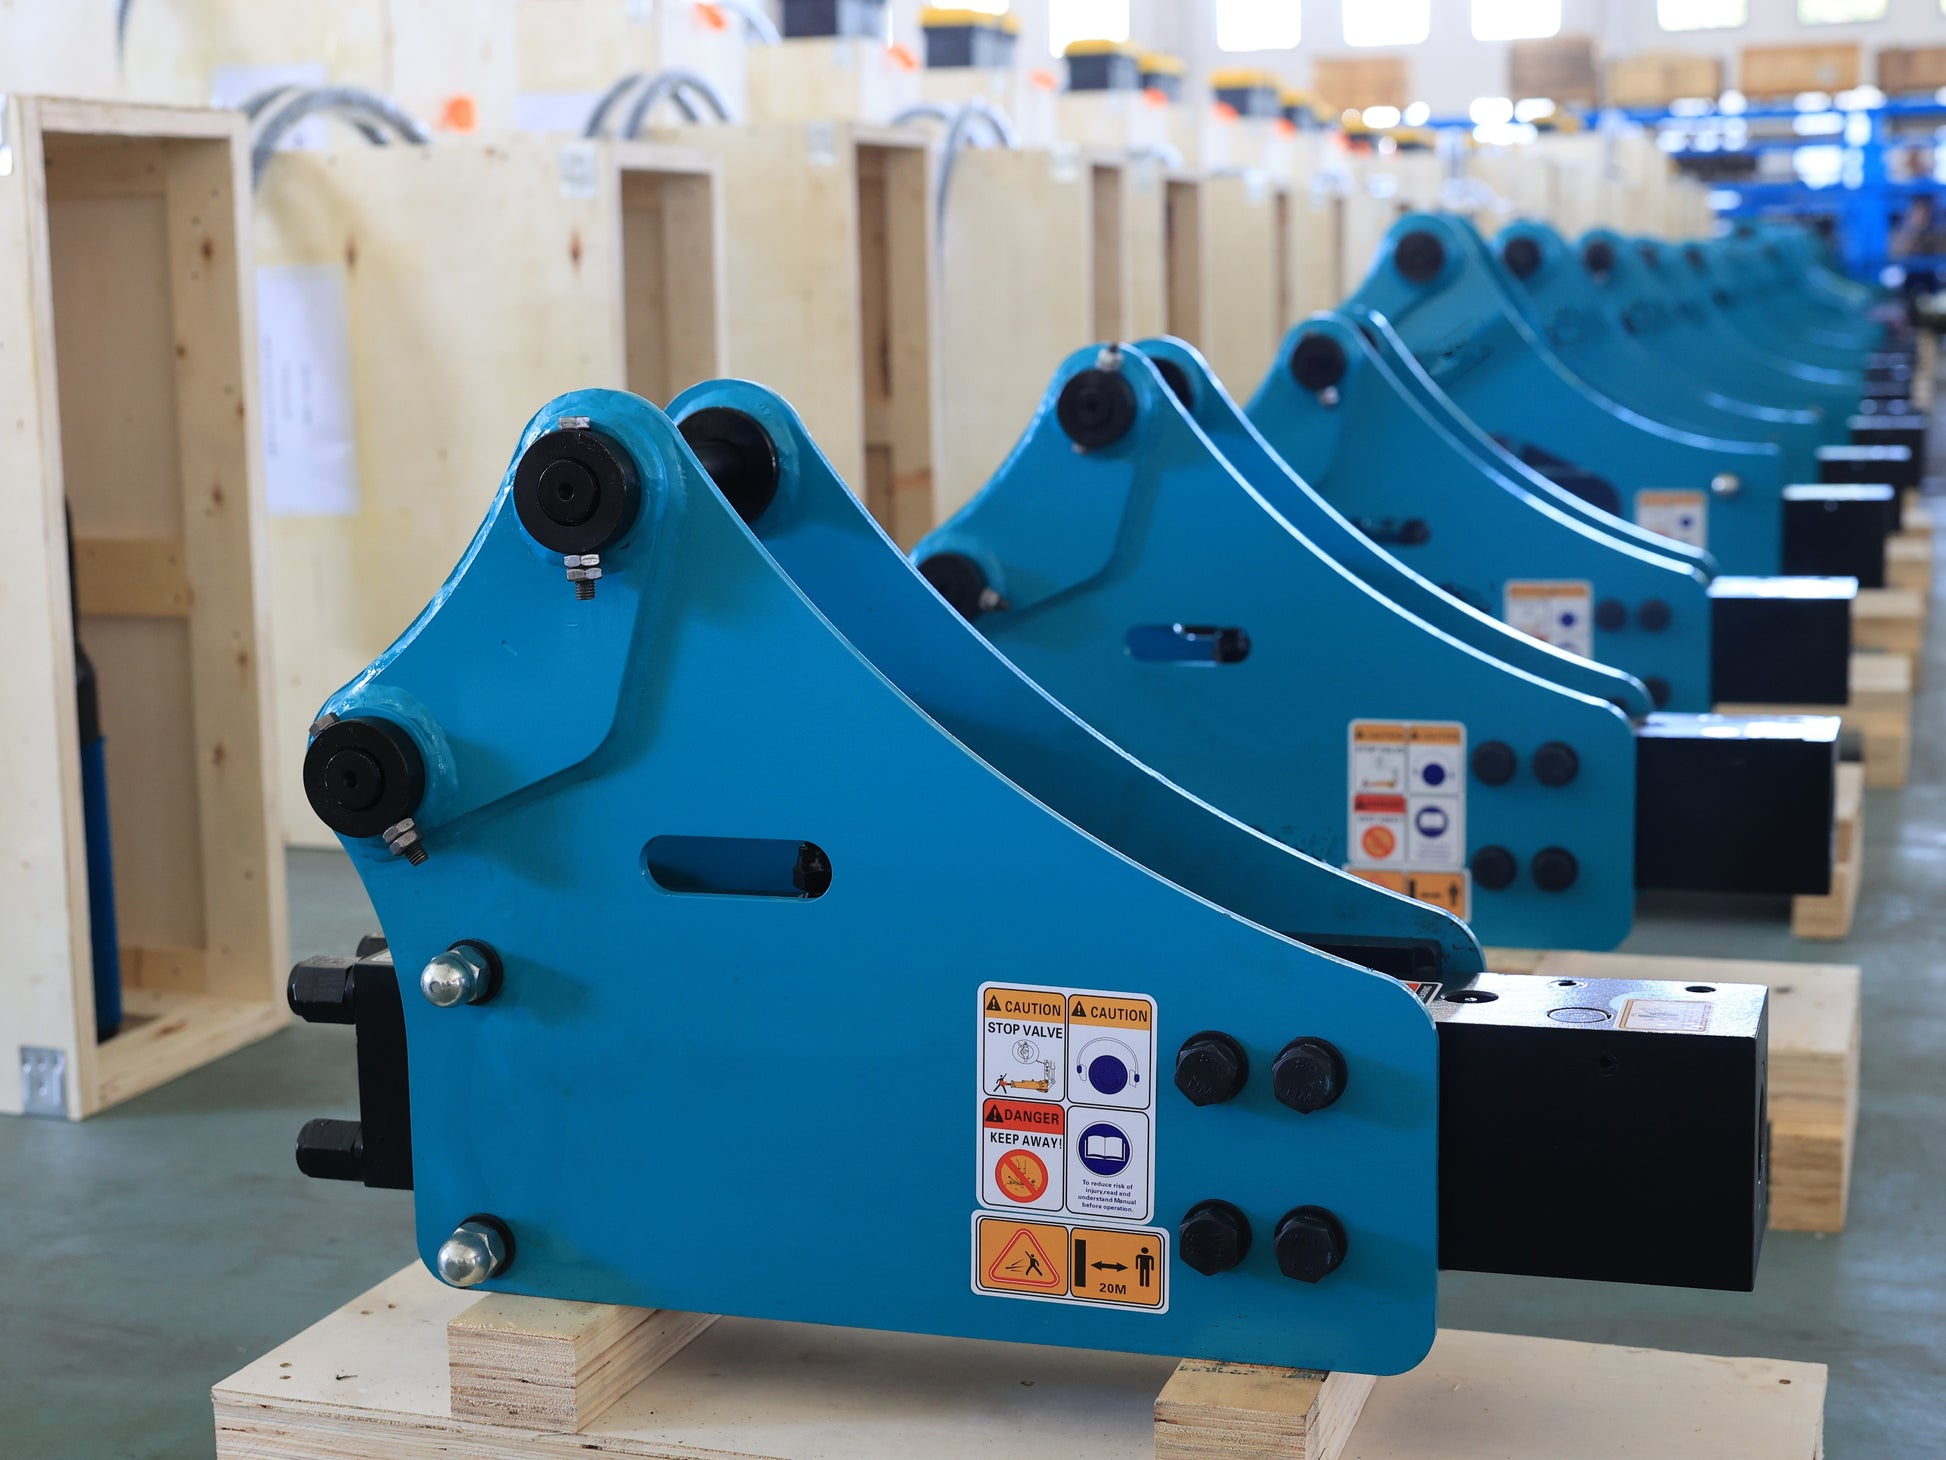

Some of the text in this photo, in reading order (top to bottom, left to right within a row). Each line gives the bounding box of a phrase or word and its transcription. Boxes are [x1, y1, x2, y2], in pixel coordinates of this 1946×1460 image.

[1005, 1000, 1061, 1016] CAUTION
[1090, 1006, 1148, 1022] CAUTION
[987, 1021, 1063, 1039] STOP VALVE
[1004, 1109, 1059, 1125] DANGER
[990, 1131, 1063, 1150] KEEP AWAY!
[1077, 1195, 1137, 1205] understand Manual
[1099, 1282, 1127, 1295] 20M
